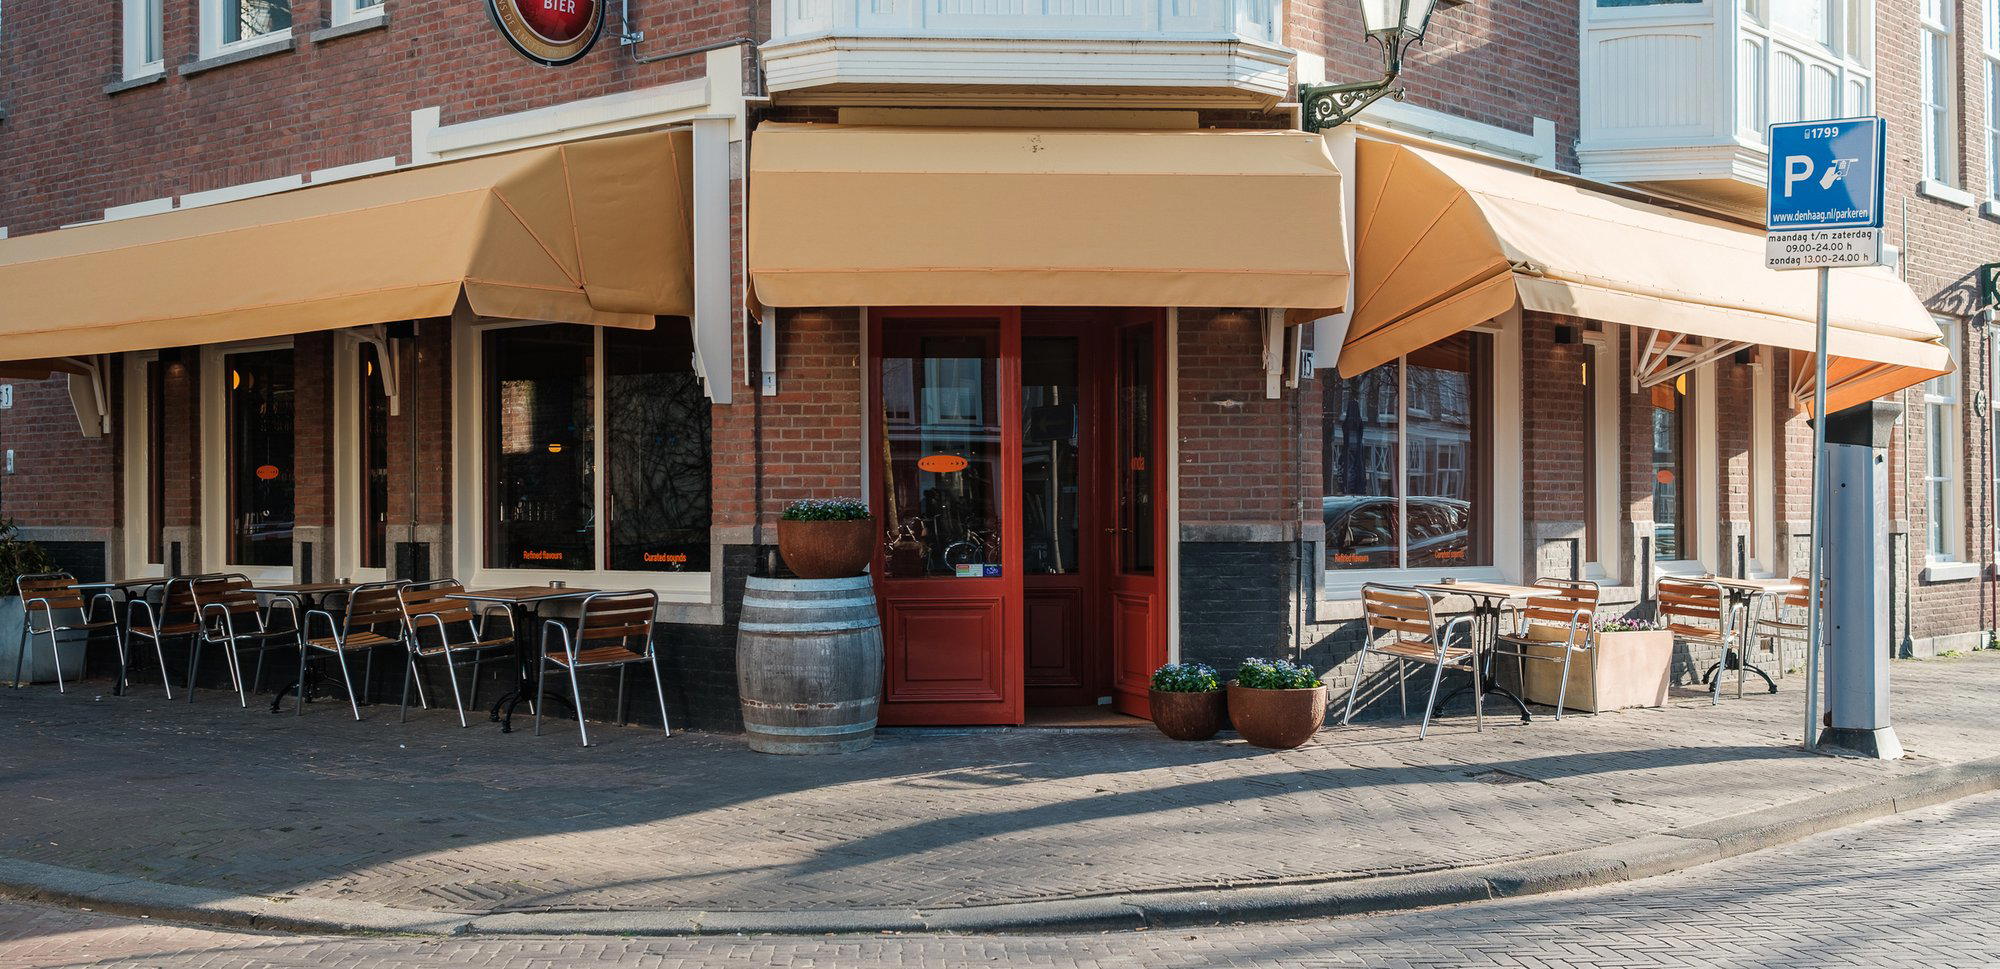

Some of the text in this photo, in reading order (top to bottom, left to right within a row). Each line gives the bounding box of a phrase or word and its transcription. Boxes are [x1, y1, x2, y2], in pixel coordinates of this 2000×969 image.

[543, 0, 576, 14] BIER
[1811, 127, 1839, 139] 1799
[1784, 155, 1815, 198] P
[1772, 208, 1868, 223] www.denhaag.nl/parkeren
[1768, 230, 1872, 243] maandag t/m zaterdag
[1786, 242, 1853, 253] 09.00-24.00 h
[1769, 253, 1869, 267] zondag 13.00-24.00 h
[1303, 352, 1313, 377] 15
[643, 552, 687, 563] Curated sounds
